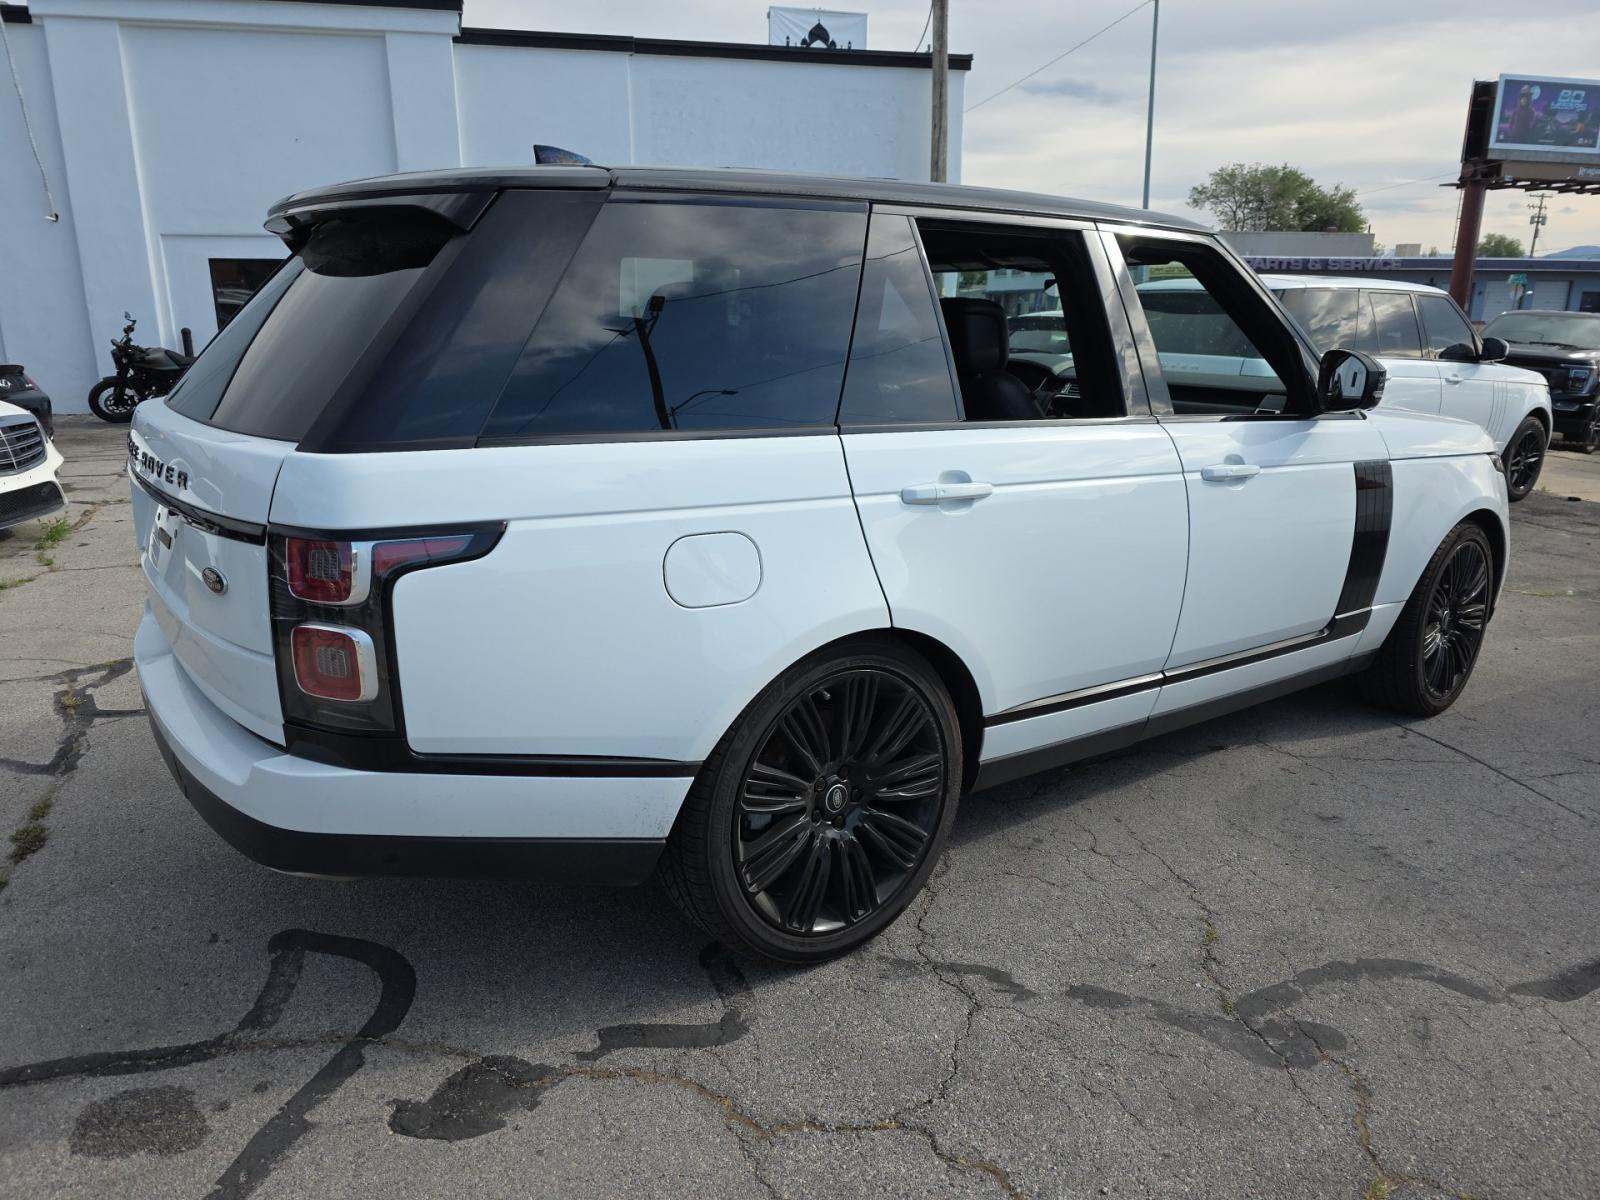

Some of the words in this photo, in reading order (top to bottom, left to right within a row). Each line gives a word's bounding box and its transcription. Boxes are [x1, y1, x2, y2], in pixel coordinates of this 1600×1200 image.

[1307, 258, 1321, 270] &
[1328, 258, 1402, 271] SERVICE
[141, 451, 189, 491] ROVER
